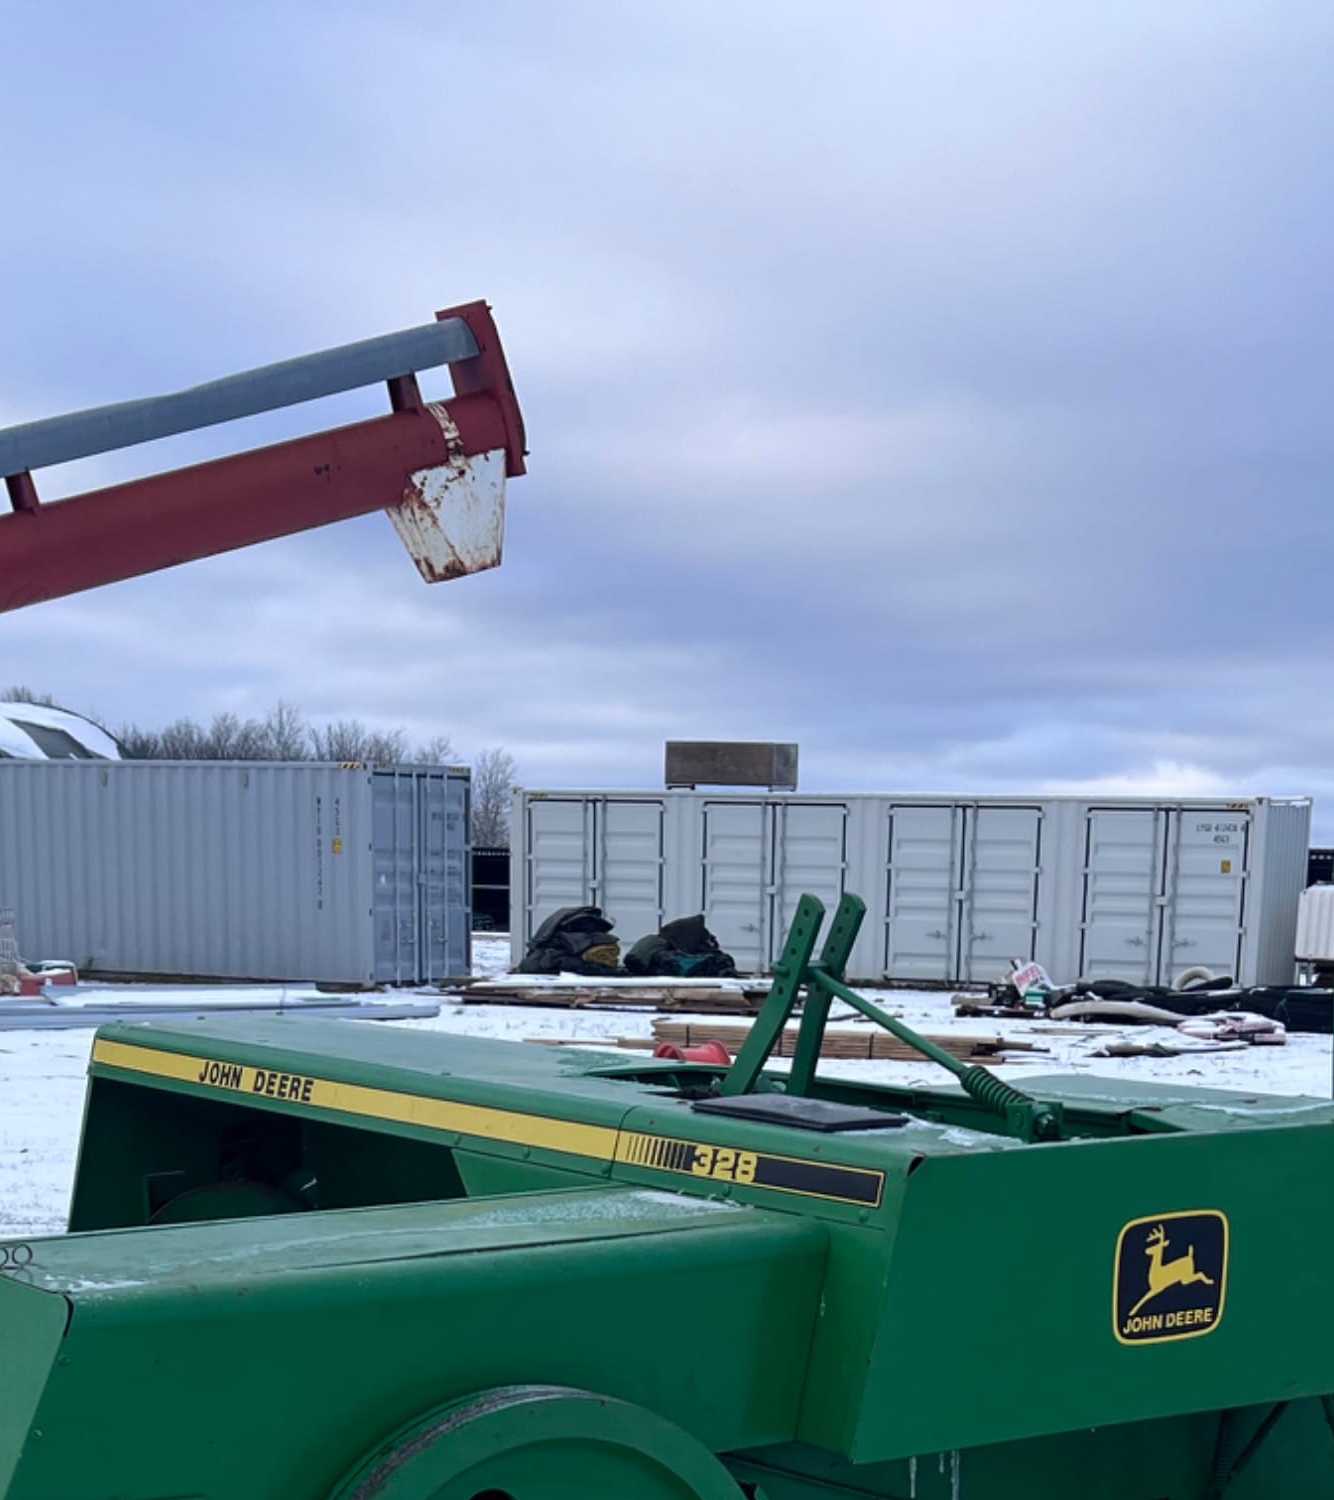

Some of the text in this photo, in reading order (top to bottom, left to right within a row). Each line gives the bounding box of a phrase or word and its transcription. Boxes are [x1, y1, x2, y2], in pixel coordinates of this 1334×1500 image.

[198, 1060, 315, 1102] JOHN DEERE
[691, 1144, 758, 1184] 328
[1122, 1307, 1214, 1335] JOHN DEERE
